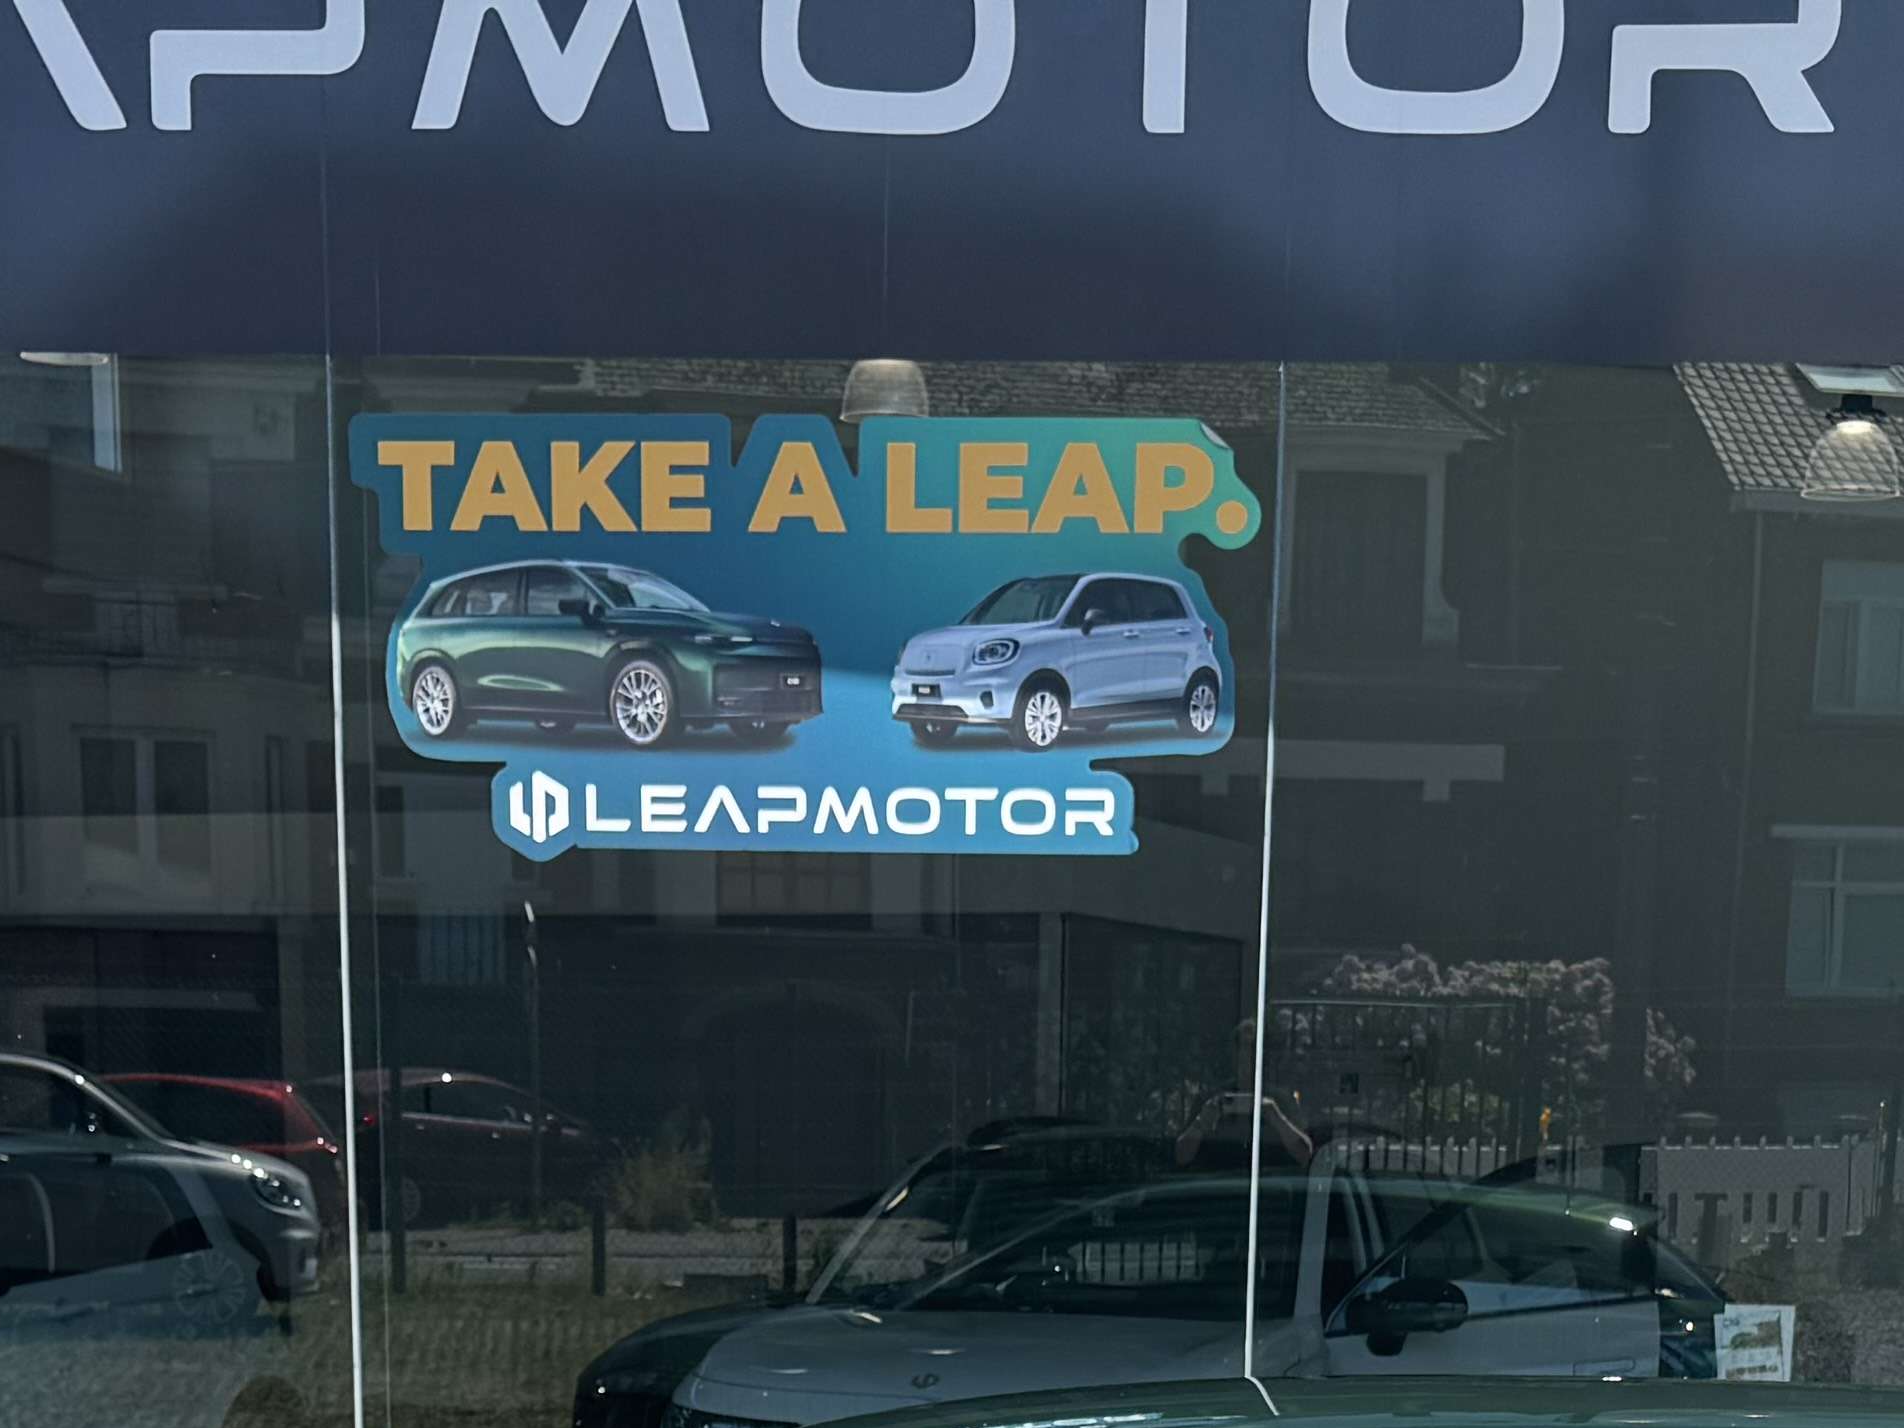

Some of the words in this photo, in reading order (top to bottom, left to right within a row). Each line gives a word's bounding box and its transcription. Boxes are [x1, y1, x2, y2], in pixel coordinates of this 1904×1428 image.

[377, 439, 712, 533] TAKE
[748, 440, 846, 533] A
[885, 441, 1250, 535] LEAP.
[585, 782, 1117, 837] LEAPMOTOR
